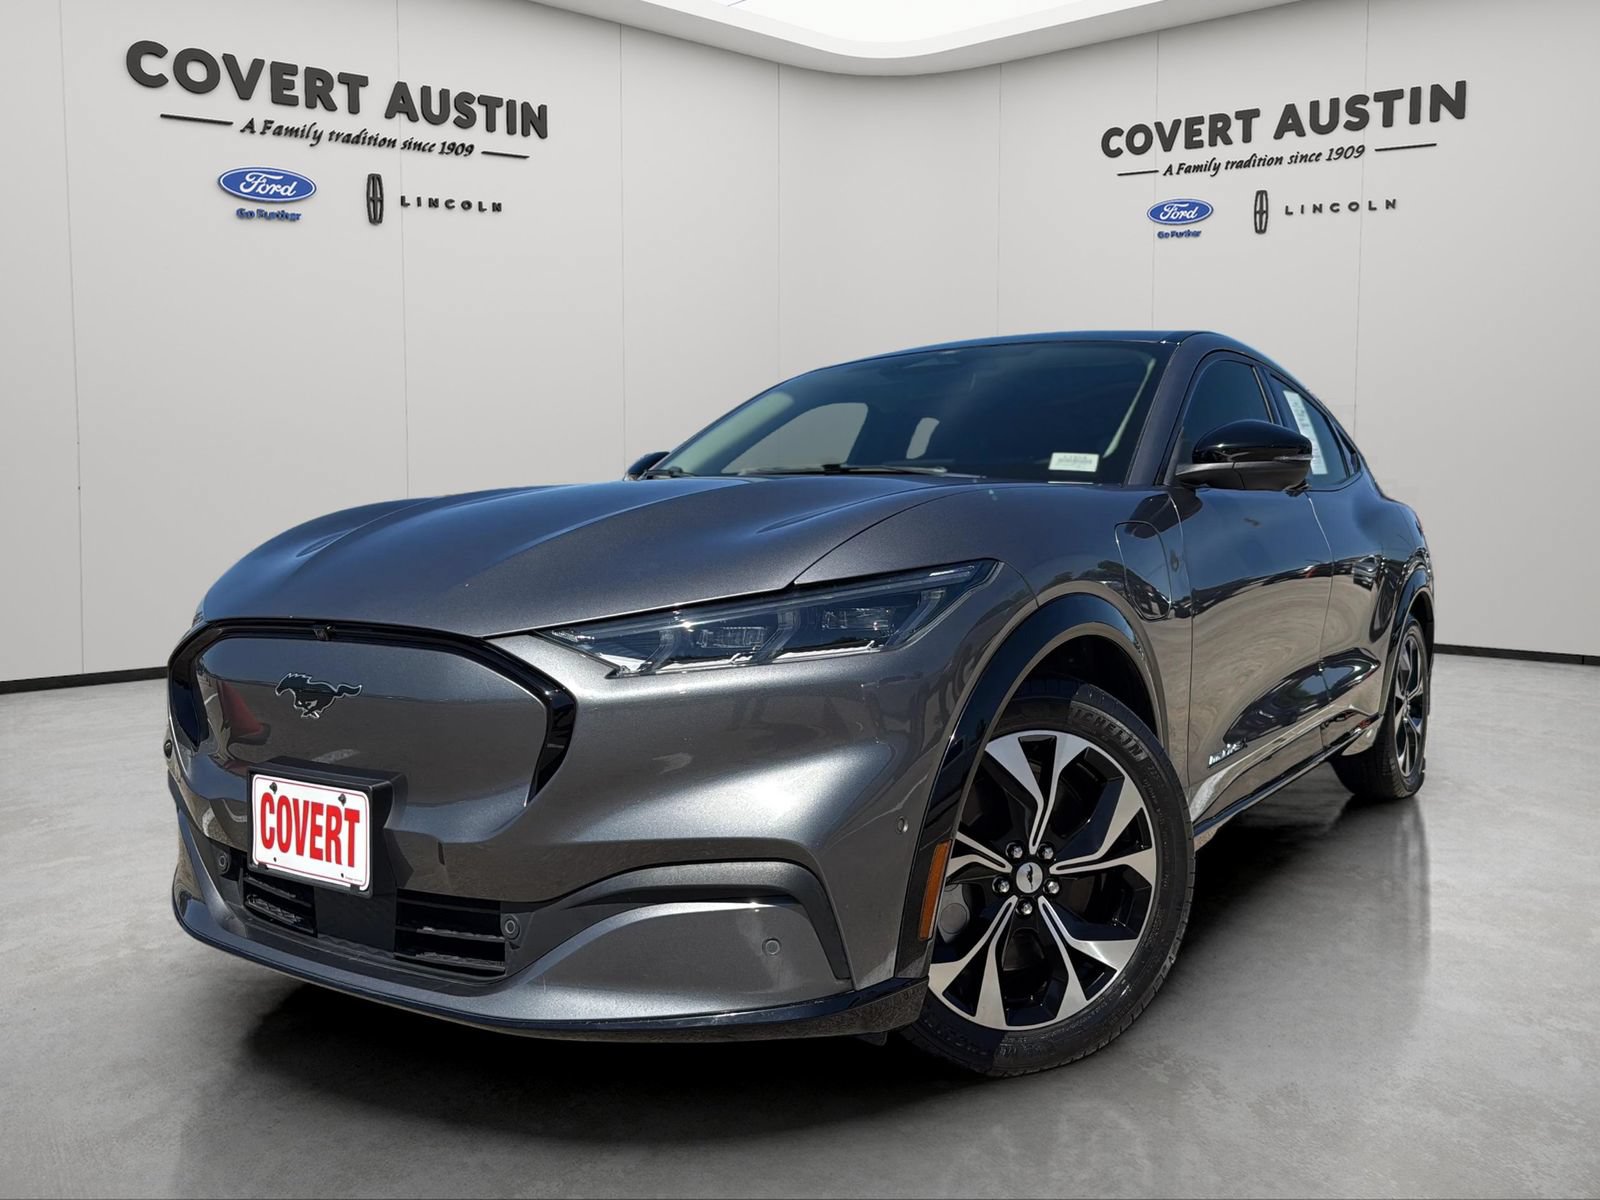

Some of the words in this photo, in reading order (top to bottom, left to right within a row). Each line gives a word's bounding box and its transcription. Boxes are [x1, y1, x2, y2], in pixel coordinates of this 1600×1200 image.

[126, 40, 369, 114] COVERT
[384, 81, 548, 139] AUSTIN
[1101, 108, 1260, 158] COVERT
[1273, 80, 1467, 140] AUSTIN
[240, 118, 256, 135] A
[260, 119, 324, 147] Family
[328, 128, 397, 149] tradition
[400, 137, 436, 154] since
[439, 140, 475, 157] 1909
[1163, 164, 1173, 176] A
[1176, 157, 1221, 177] Family
[1224, 153, 1283, 171] tradition
[1287, 151, 1323, 164] since
[1325, 144, 1366, 161] 1909
[240, 172, 297, 196] Ford
[236, 208, 255, 219] Go
[400, 195, 502, 213] LINCOLN
[1160, 203, 1199, 220] Ford
[1285, 198, 1397, 216] LINCOLN
[1157, 231, 1170, 239] Go
[260, 792, 360, 868] COVERT
